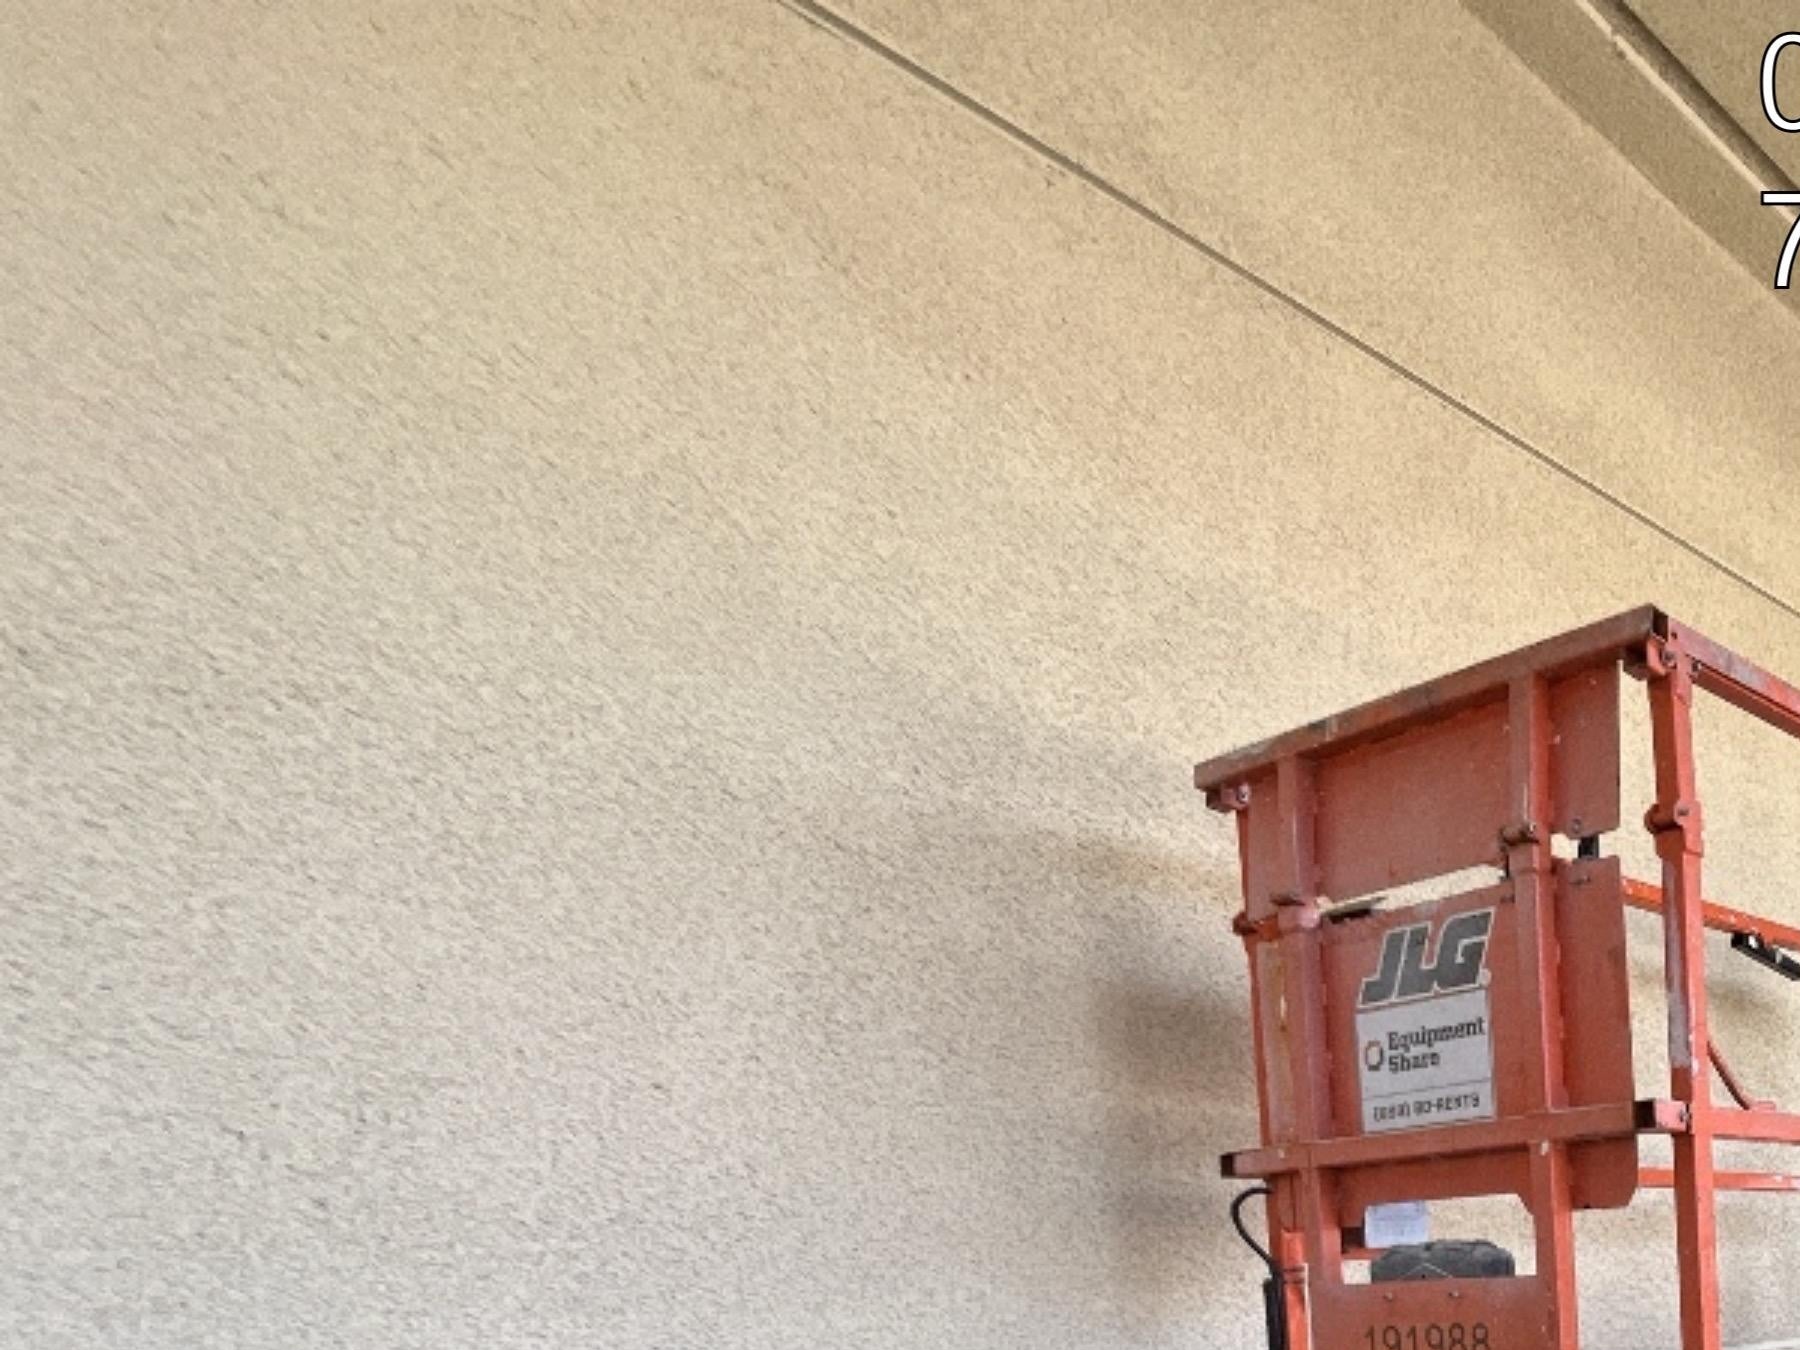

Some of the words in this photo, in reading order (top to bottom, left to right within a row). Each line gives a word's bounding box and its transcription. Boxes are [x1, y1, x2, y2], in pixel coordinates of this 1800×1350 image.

[1357, 906, 1495, 1008] JLG
[1387, 1016, 1485, 1053] Equipment
[1387, 1051, 1441, 1074] Share
